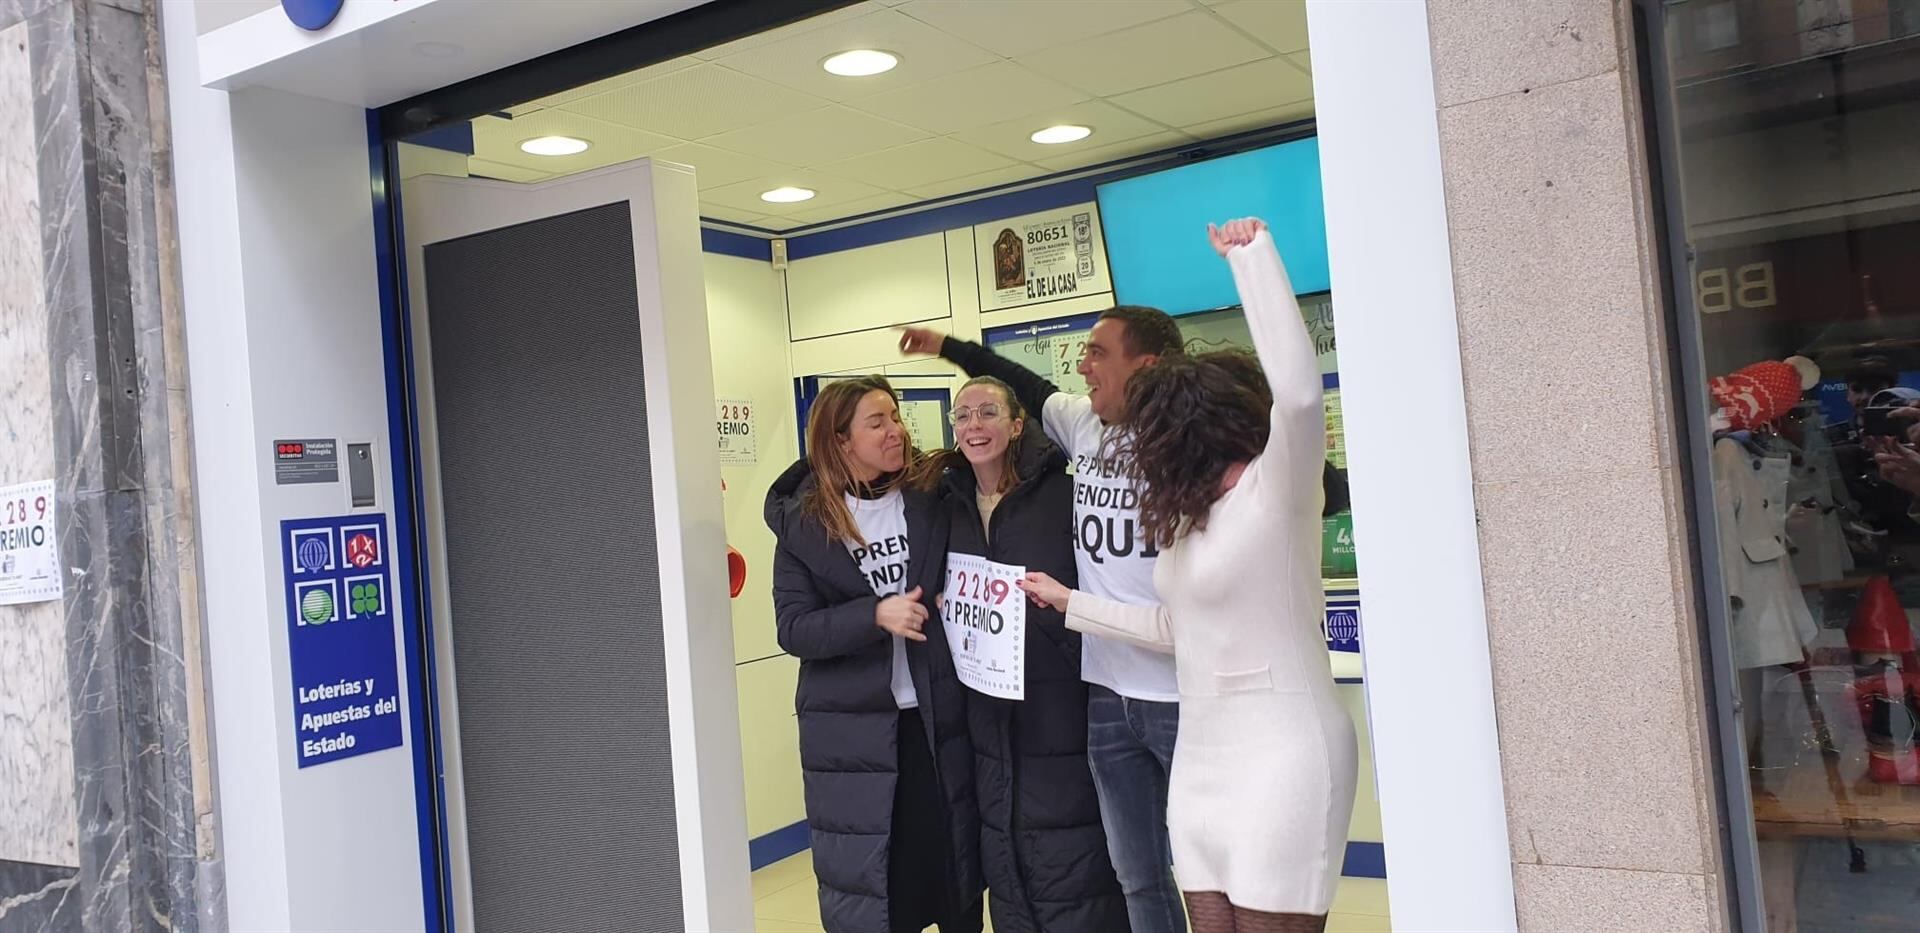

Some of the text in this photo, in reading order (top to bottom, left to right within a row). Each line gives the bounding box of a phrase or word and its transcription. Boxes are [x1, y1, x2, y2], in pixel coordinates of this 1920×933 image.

[1027, 225, 1069, 245] 80651
[1027, 279, 1036, 299] EL
[1037, 277, 1046, 297] DE
[1047, 275, 1057, 296] LA
[1058, 272, 1078, 294] CASA
[306, 448, 332, 456] Protegida
[955, 600, 1004, 635] PREMIO
[299, 678, 374, 704] Loterías y
[301, 696, 397, 733] Apuestas del
[303, 732, 356, 758] Estado
